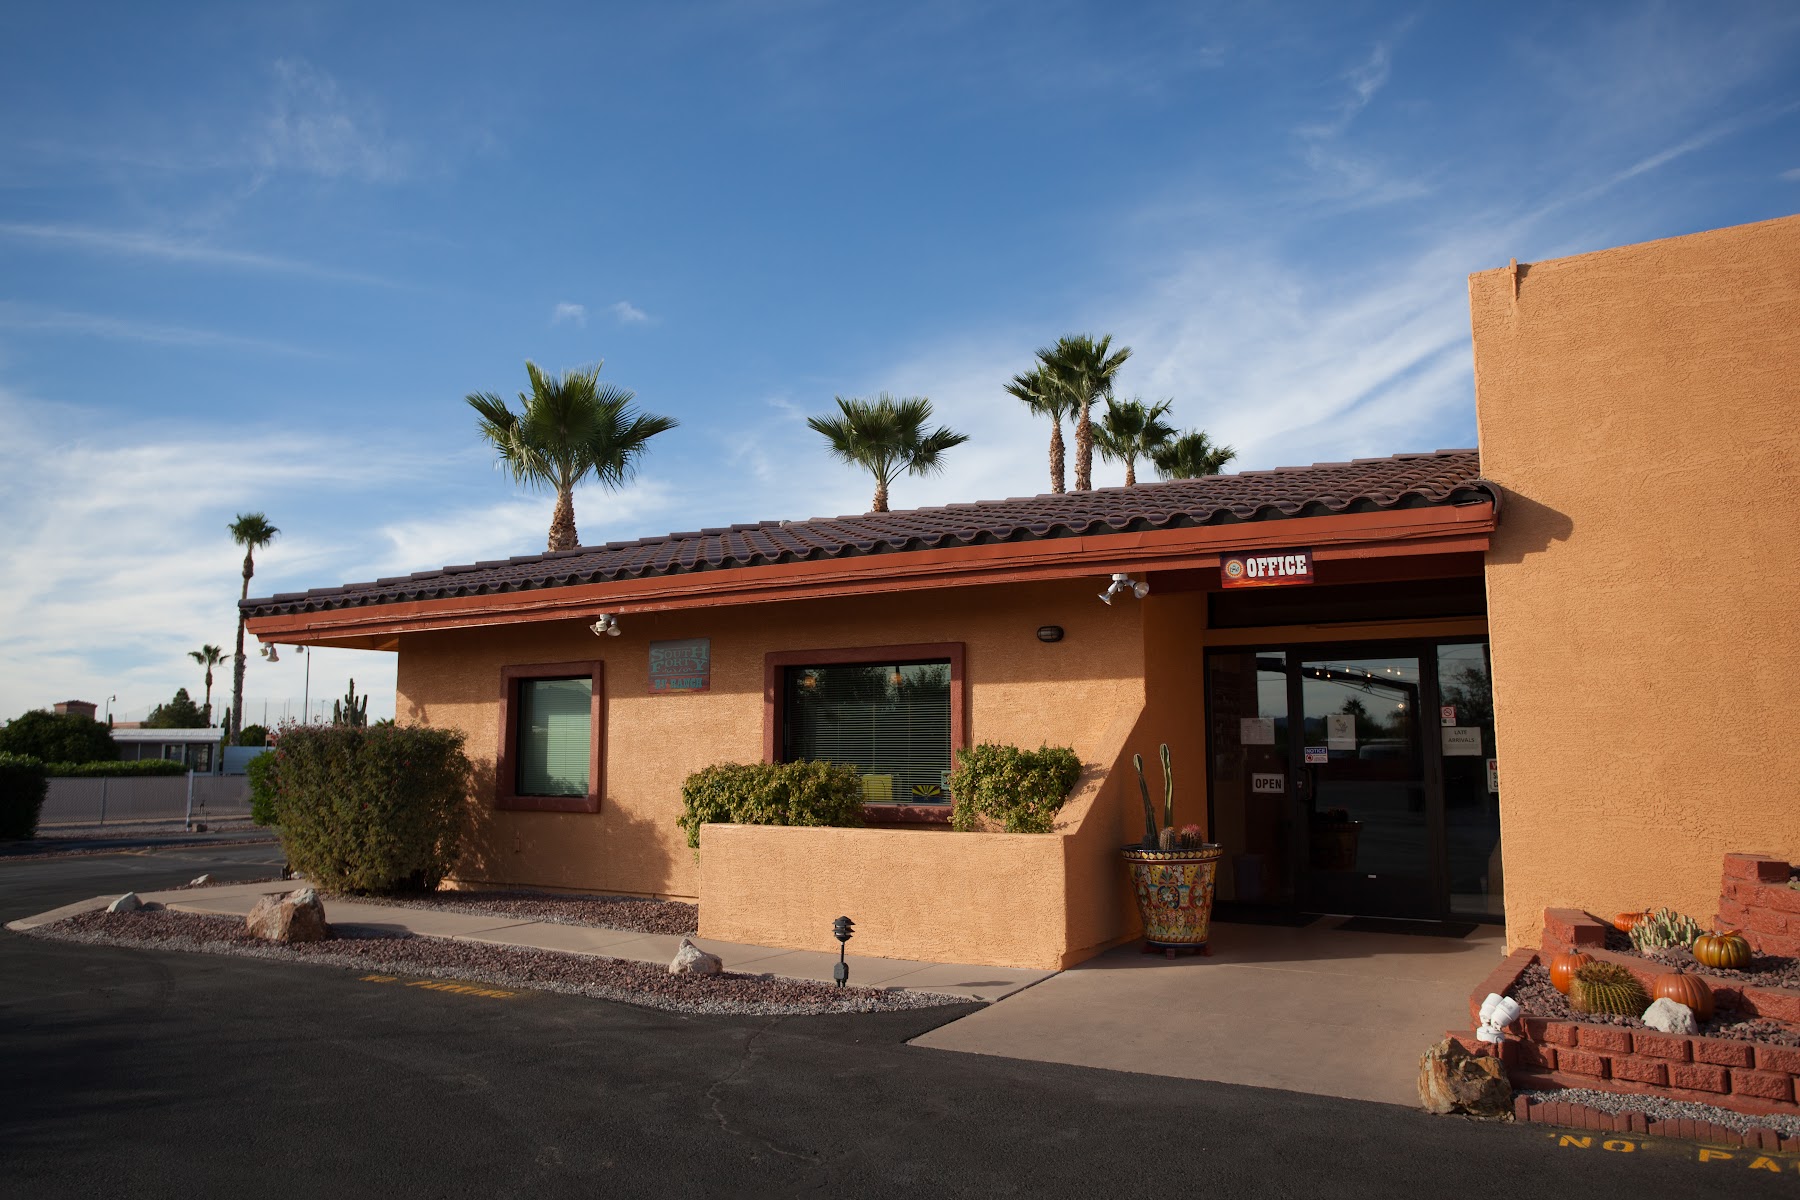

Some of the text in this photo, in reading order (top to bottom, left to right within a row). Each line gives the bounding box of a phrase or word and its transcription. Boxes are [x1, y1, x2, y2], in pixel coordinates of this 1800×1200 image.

[1246, 555, 1307, 578] OFFICE
[651, 646, 707, 662] SOUTH
[651, 658, 708, 672] FORTY
[670, 677, 702, 688] RANCH
[1255, 778, 1282, 789] OPEN
[1558, 1134, 1800, 1174] NO PA
